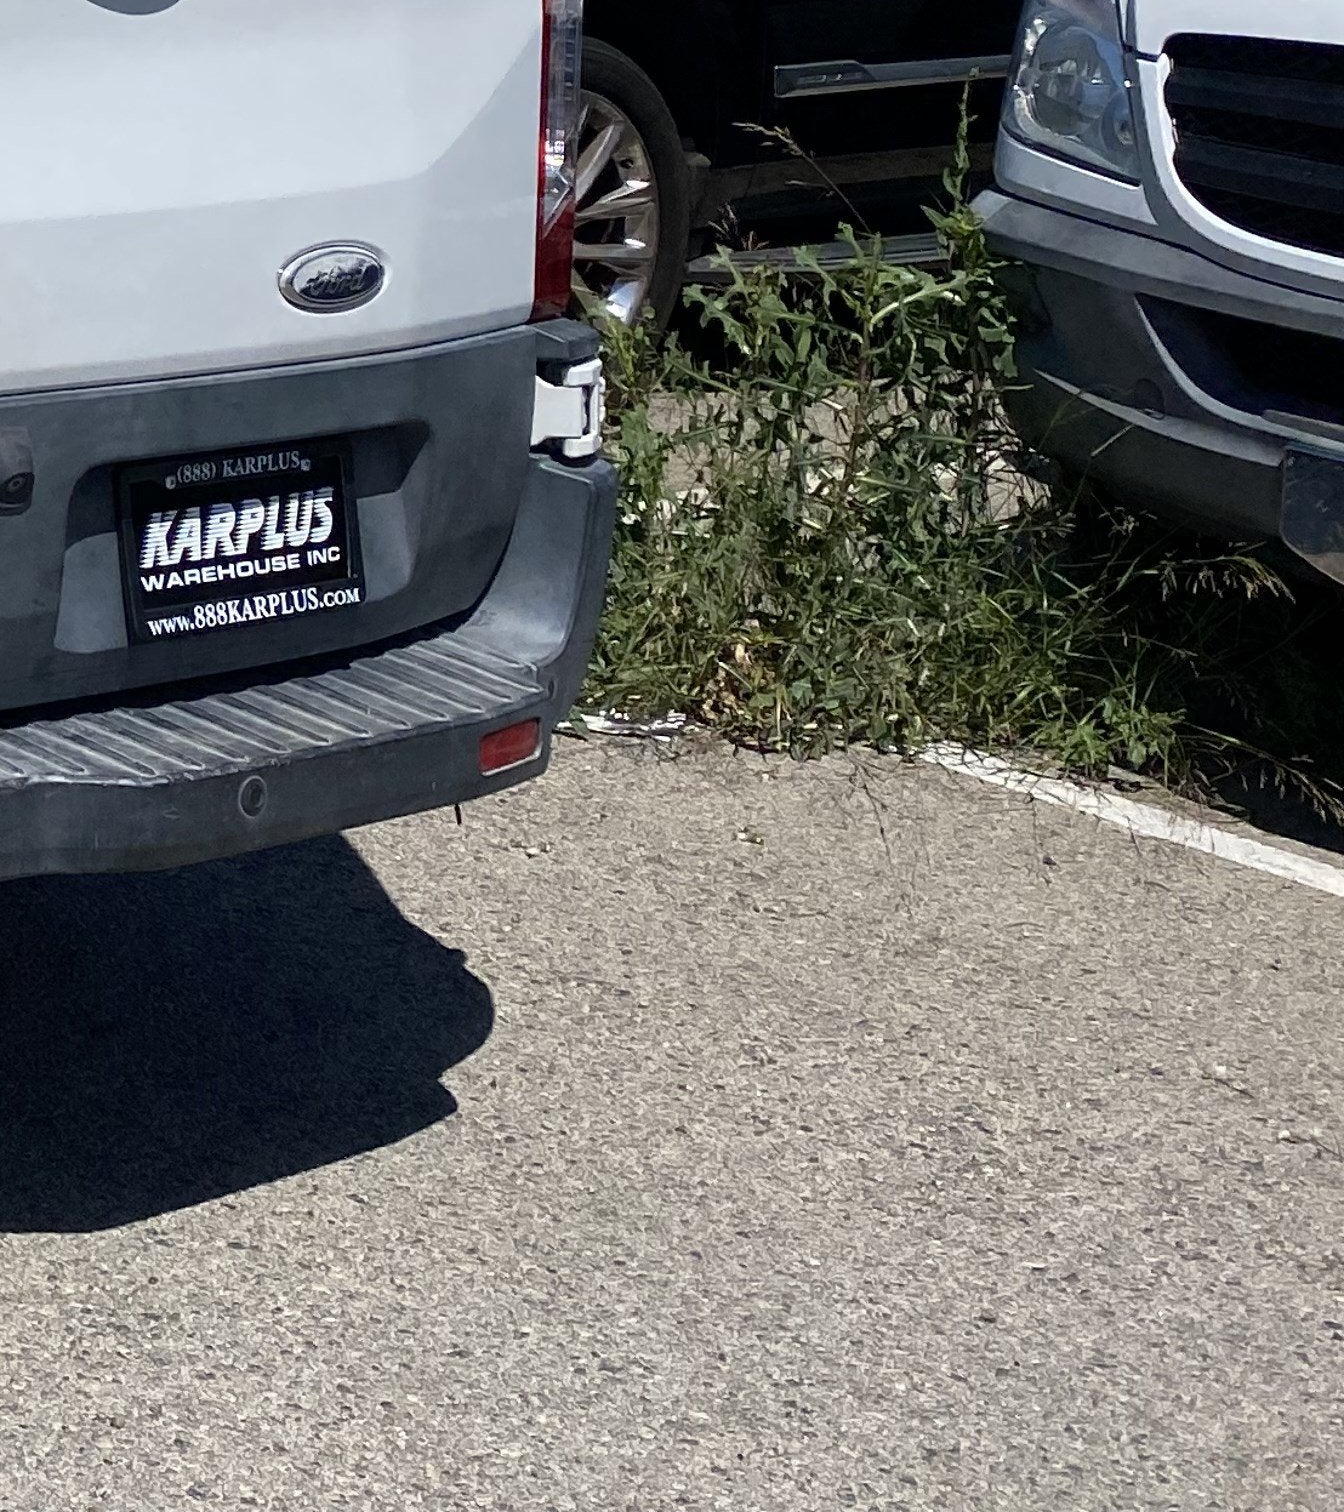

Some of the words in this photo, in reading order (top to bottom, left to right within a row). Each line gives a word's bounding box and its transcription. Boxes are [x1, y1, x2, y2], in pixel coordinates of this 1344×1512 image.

[176, 462, 217, 483] (888)
[222, 451, 300, 478] KARPLUS
[139, 487, 334, 569] KARPLUS
[140, 553, 301, 592] WAREHOUSE
[307, 546, 340, 566] INC
